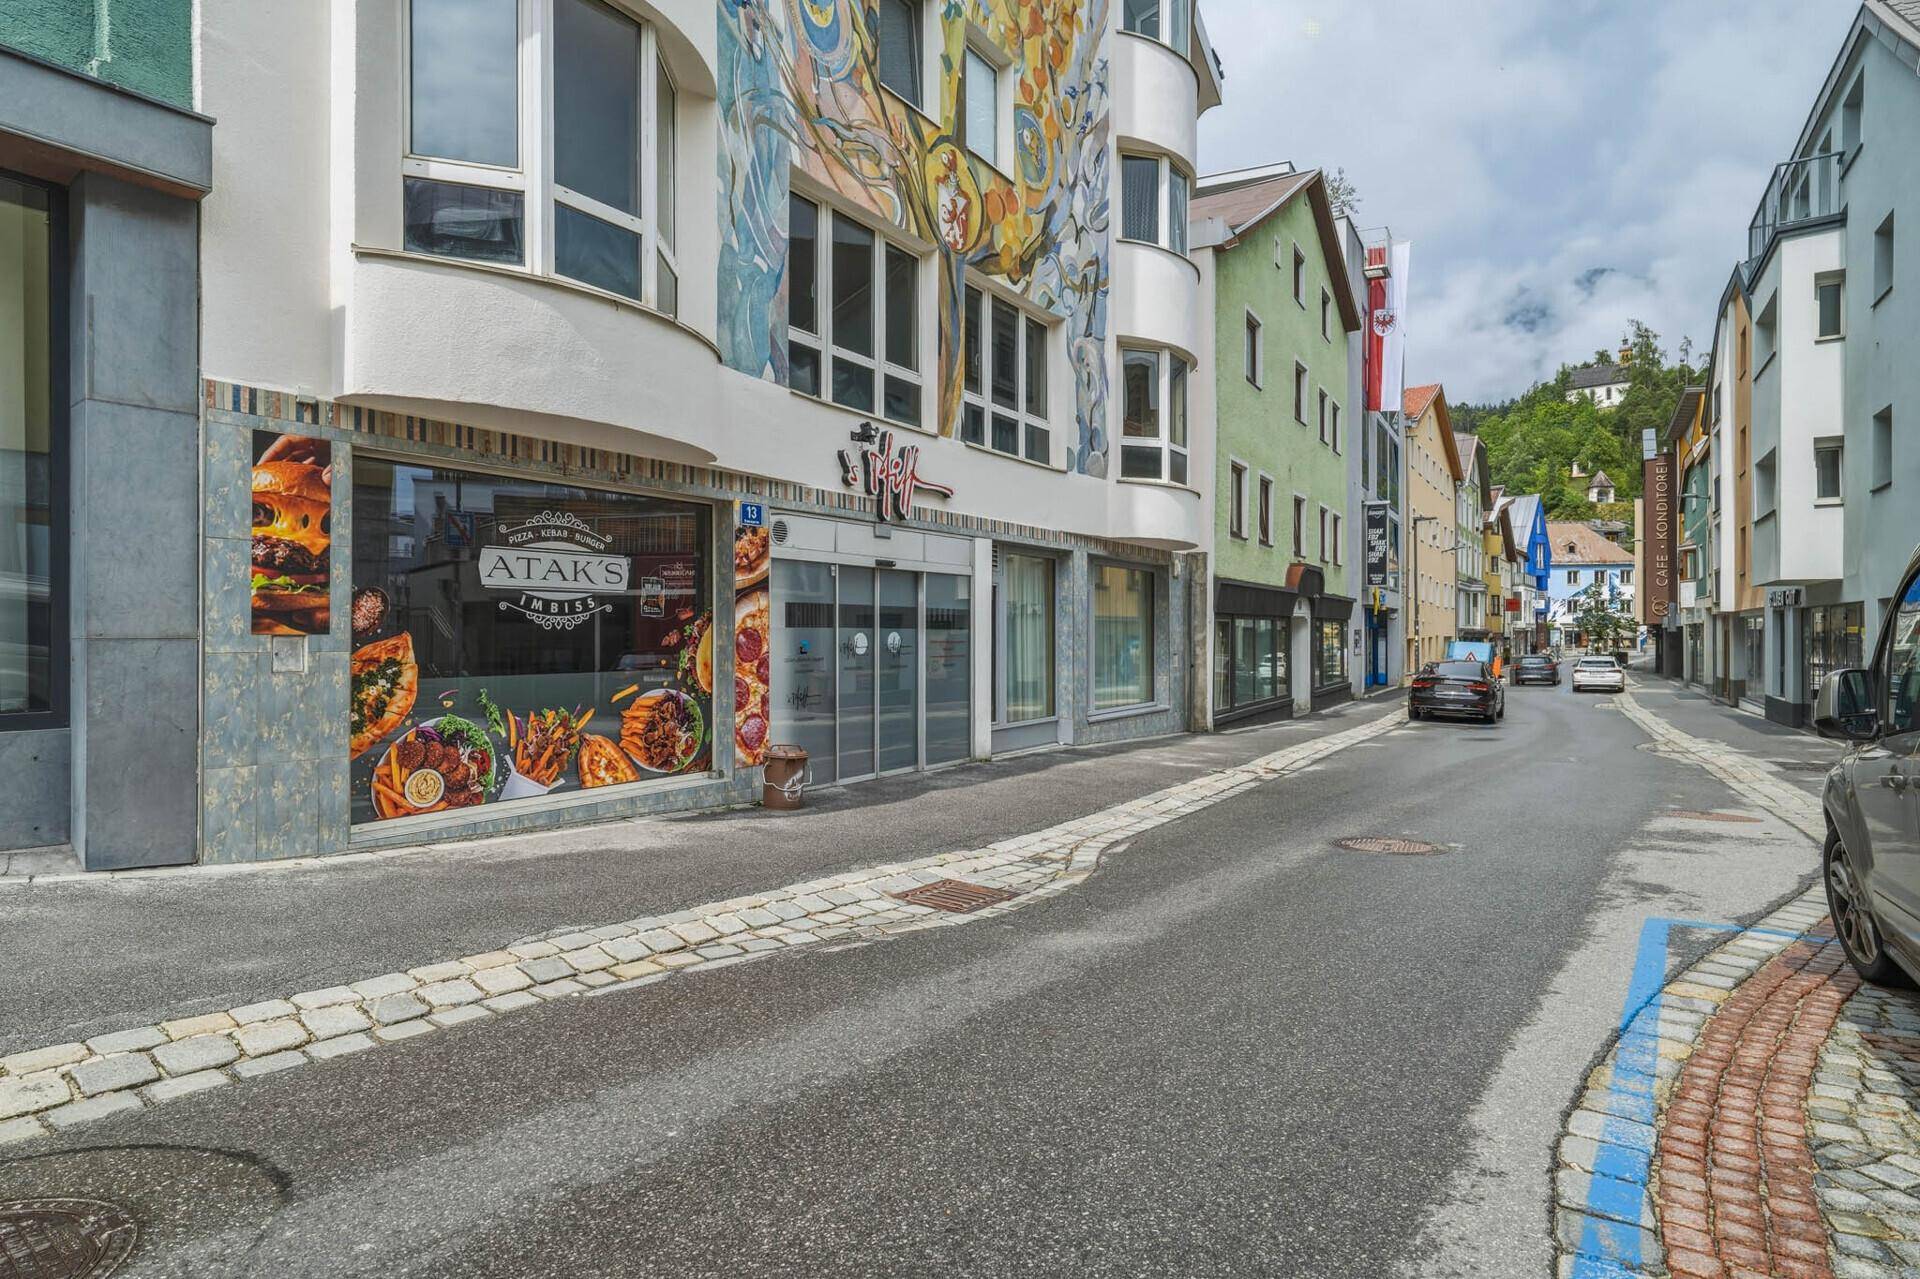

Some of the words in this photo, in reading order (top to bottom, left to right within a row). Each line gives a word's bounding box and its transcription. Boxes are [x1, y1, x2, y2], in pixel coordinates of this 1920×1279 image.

[746, 505, 757, 519] 13
[1656, 463, 1668, 540] KONDITOREI
[508, 531, 534, 544] PIZZA
[541, 529, 568, 538] KEBAB
[575, 533, 605, 551] BURGER
[1656, 554, 1668, 587] CAFE
[520, 594, 595, 613] IMBISS
